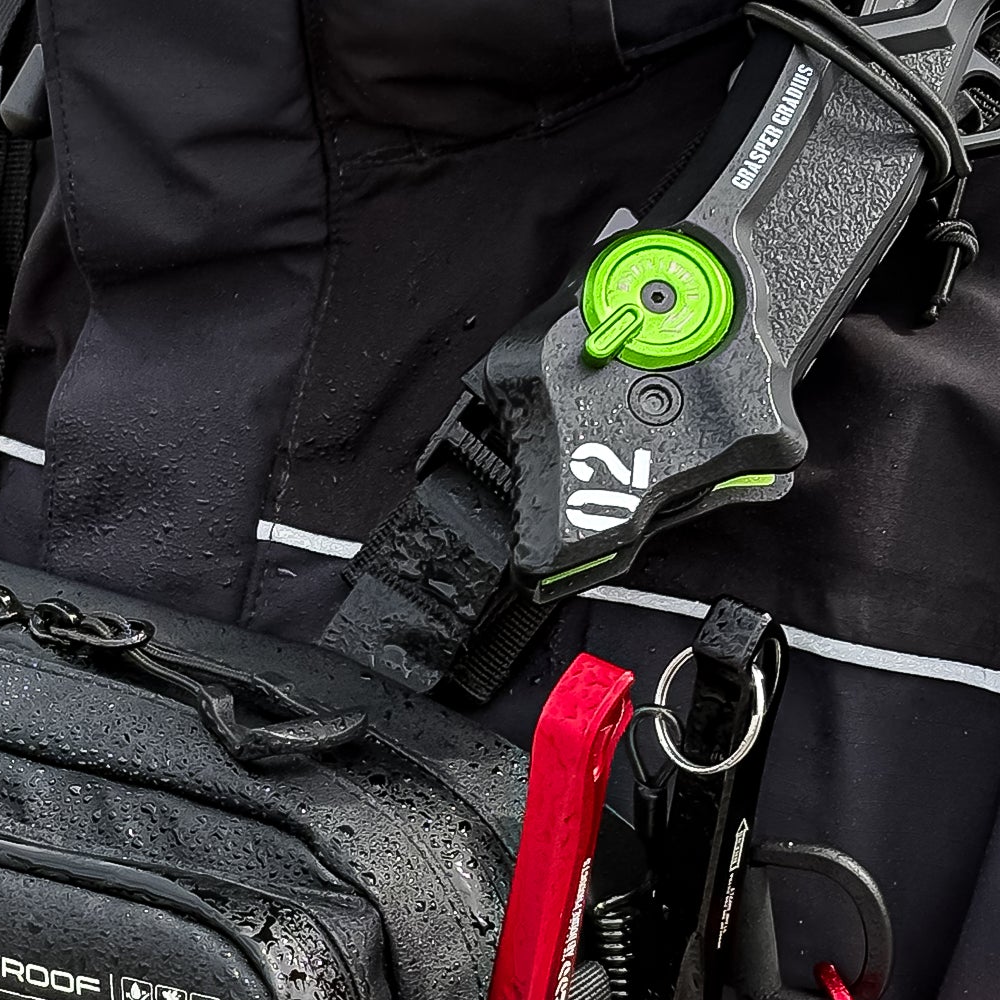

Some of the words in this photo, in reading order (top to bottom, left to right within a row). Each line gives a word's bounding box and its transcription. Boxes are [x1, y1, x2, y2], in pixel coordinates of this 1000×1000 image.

[731, 124, 784, 190] GRASPER
[771, 63, 814, 126] GRADIUS
[565, 442, 652, 532] 02
